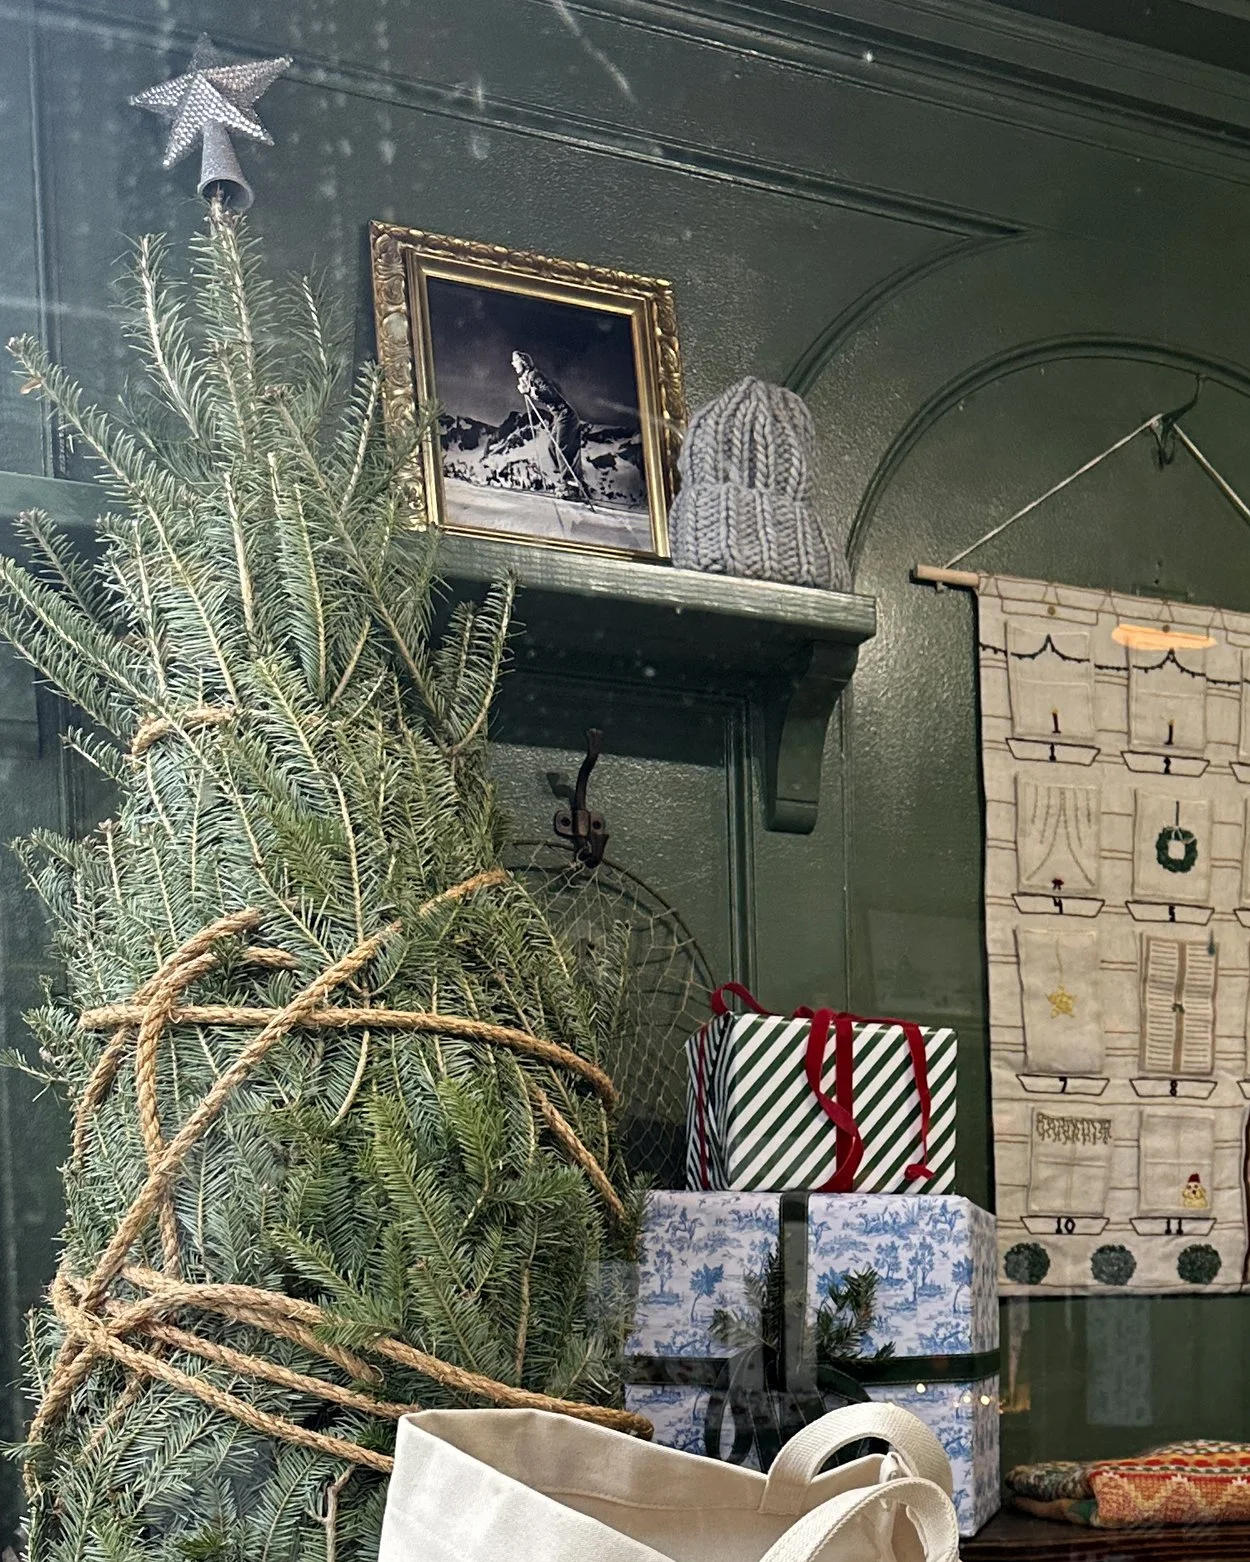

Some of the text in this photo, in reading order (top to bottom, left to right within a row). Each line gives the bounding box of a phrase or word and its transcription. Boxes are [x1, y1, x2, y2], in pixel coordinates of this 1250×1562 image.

[1048, 742, 1057, 761] 1
[1163, 757, 1171, 775] 2
[1053, 897, 1063, 914] 4
[1168, 906, 1176, 922] 5
[1057, 1078, 1068, 1094] 7
[1169, 1080, 1178, 1097] 8
[1055, 1217, 1076, 1233] 10
[1164, 1217, 1184, 1235] 11
